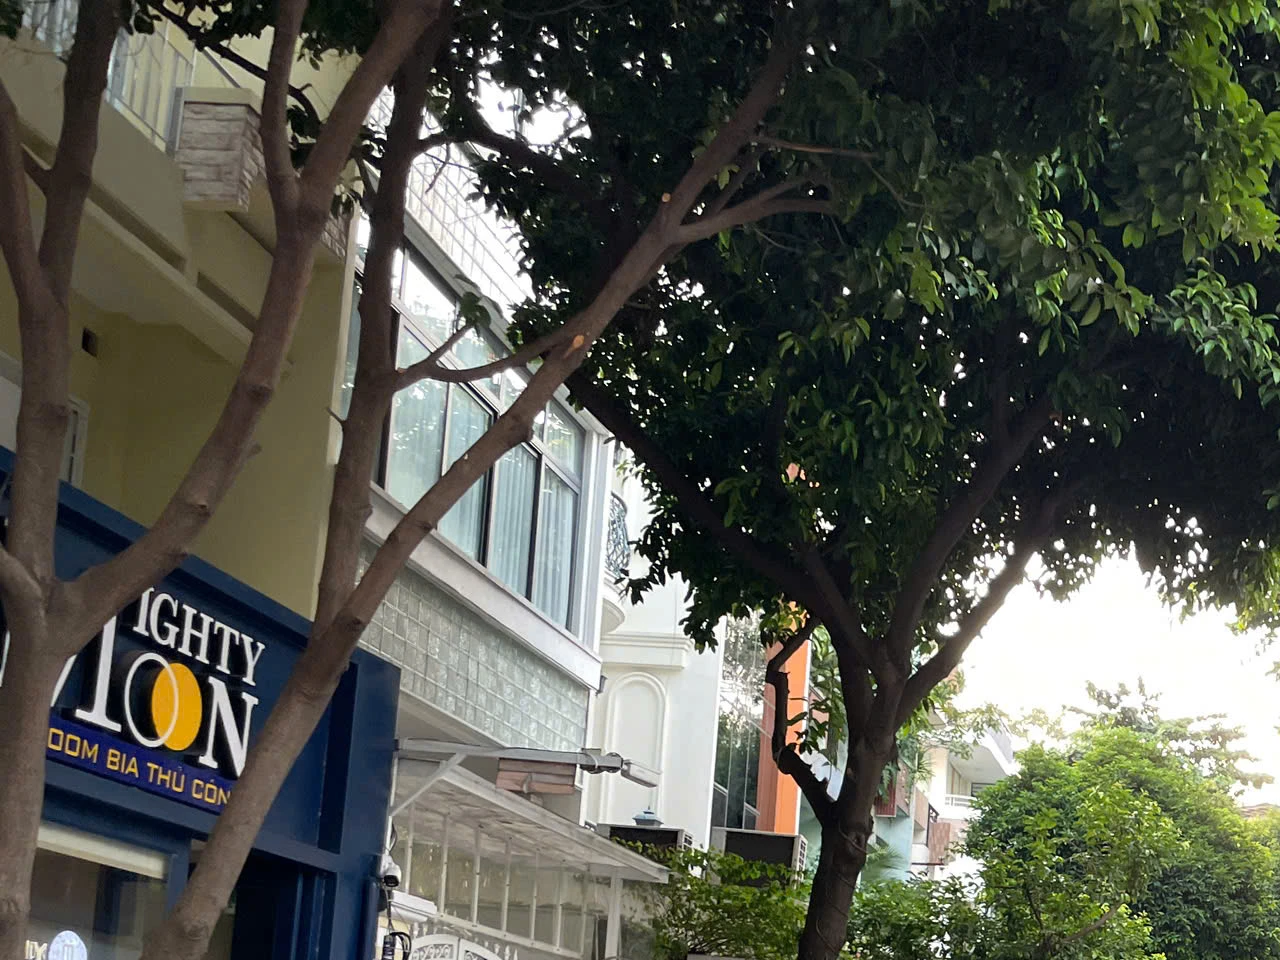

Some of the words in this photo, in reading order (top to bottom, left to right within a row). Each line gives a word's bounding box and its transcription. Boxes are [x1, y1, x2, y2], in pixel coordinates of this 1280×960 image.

[132, 587, 265, 687] IGHTY
[47, 728, 99, 763] OOM
[106, 751, 139, 779] BIA
[192, 779, 231, 805] CÔN
